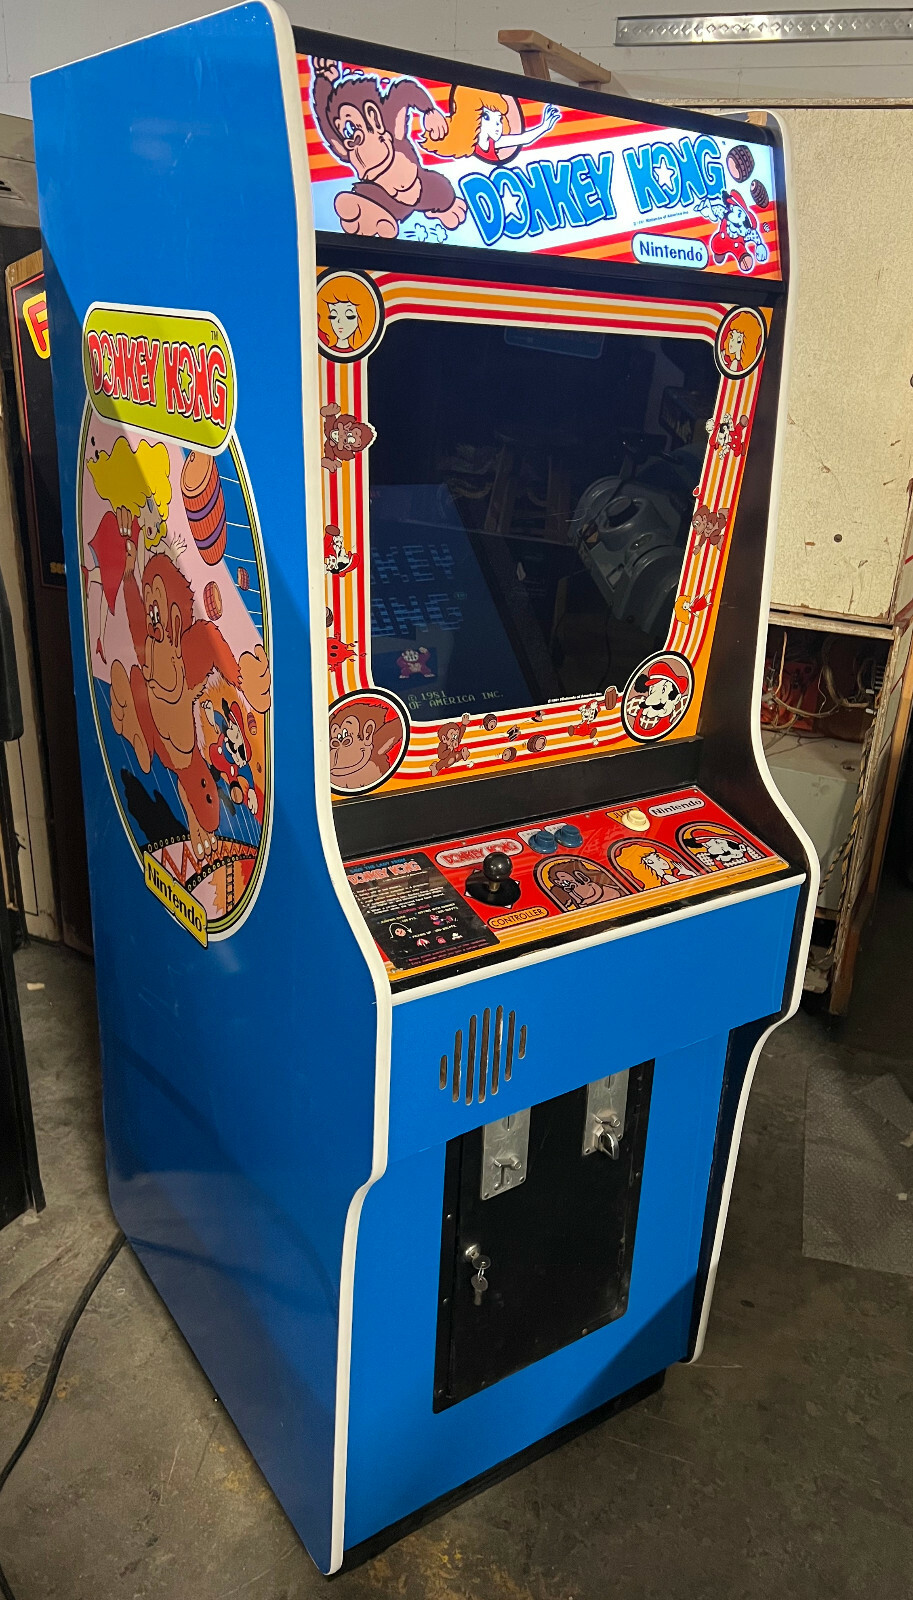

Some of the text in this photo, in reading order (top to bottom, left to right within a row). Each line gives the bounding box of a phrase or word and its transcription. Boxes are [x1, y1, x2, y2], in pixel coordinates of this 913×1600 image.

[460, 151, 616, 246] DONKEY
[624, 135, 725, 214] KONG
[639, 240, 703, 262] Nintendo
[87, 331, 228, 428] DONKEY KONG
[409, 690, 504, 710] OF AMERICA INC.
[421, 690, 446, 700] 1981
[651, 799, 703, 816] Nintendo
[442, 846, 484, 866] DONKEY
[348, 869, 387, 886] DONKEY
[388, 861, 421, 876] KONG
[147, 862, 204, 933] Nintendo
[490, 908, 545, 927] CONTROLLER
